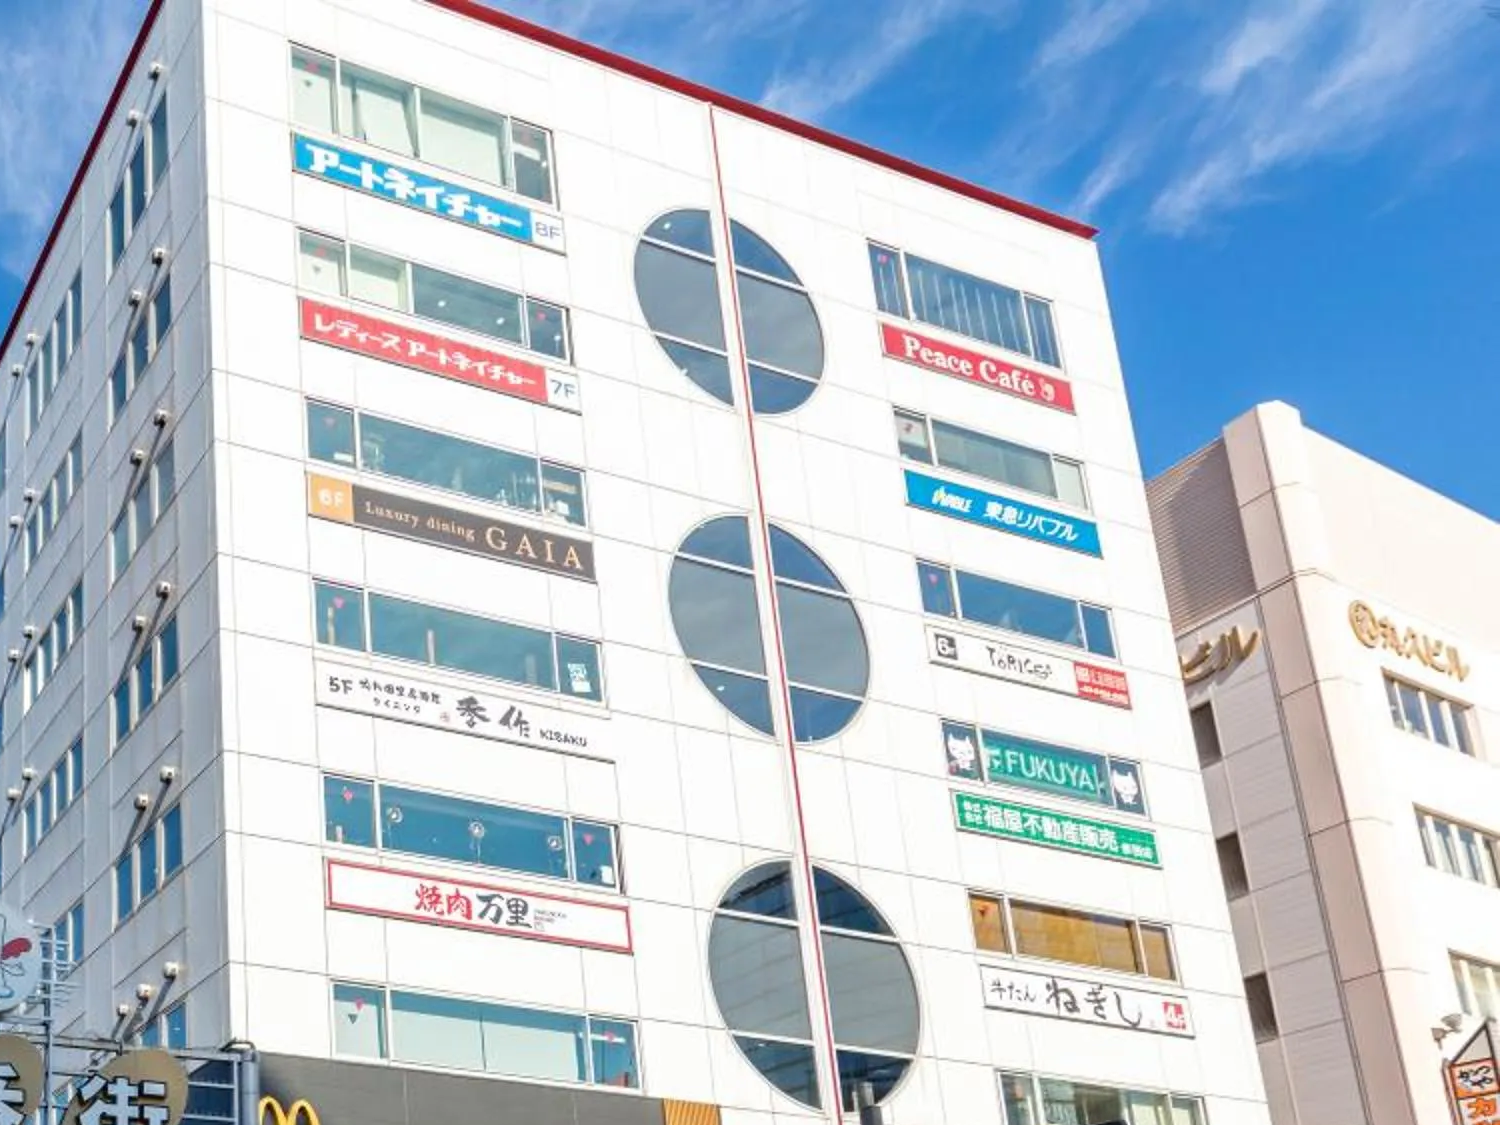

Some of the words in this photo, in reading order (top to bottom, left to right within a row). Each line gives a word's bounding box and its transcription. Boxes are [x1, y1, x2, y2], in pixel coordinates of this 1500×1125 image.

[305, 143, 522, 228] アートネイチャー
[313, 312, 400, 352] レディース
[407, 338, 536, 387] アートネイチャー
[550, 379, 575, 399] 7F
[902, 333, 973, 377] Peace
[979, 359, 1036, 398] Café
[318, 487, 345, 509] 6F
[365, 501, 420, 528] Luxury
[427, 517, 476, 543] dining
[485, 526, 584, 570] GAIA
[984, 502, 1079, 541] 東急リバブル
[329, 676, 353, 694] 5F
[1006, 750, 1095, 790] FUKUYA
[415, 883, 533, 929] 焼肉万里
[990, 978, 1037, 1003] 牛たん
[1045, 975, 1143, 1029] ねぎし
